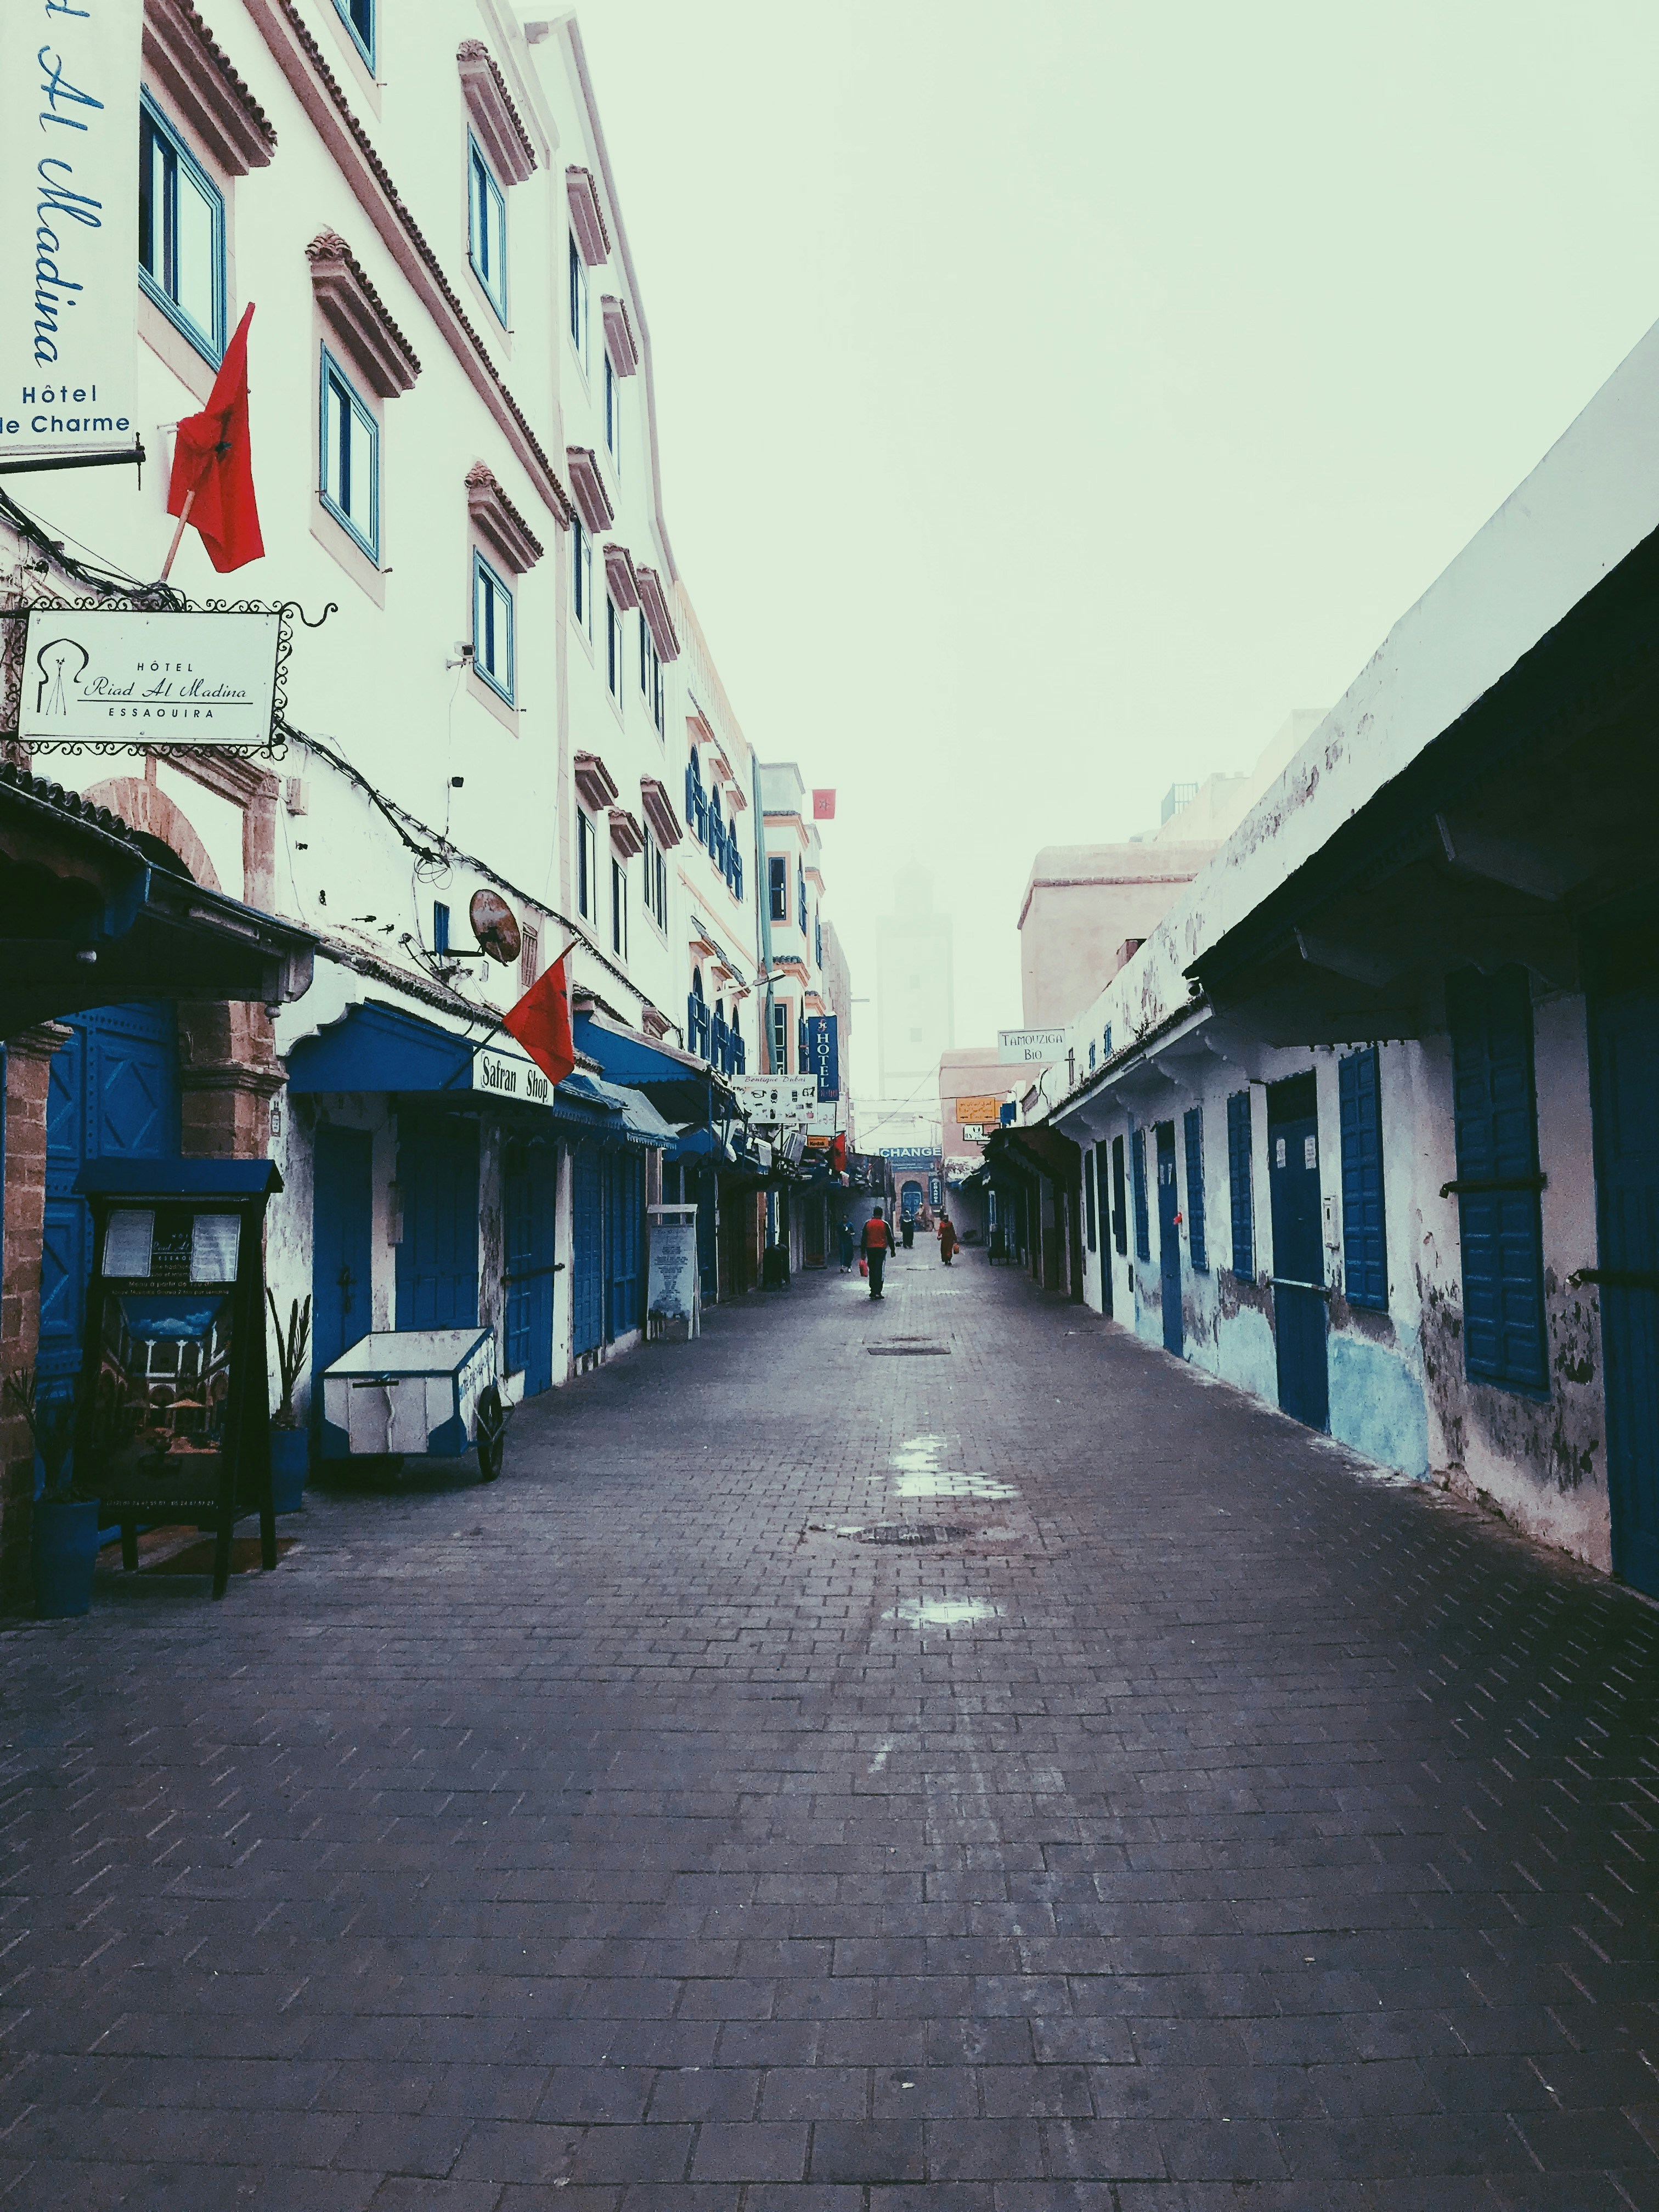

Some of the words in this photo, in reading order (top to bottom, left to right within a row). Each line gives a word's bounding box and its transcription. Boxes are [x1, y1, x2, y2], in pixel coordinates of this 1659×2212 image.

[35, 158, 103, 368] Madina
[22, 385, 96, 404] Hôtel
[31, 415, 129, 433] Charme
[137, 660, 193, 672] HÔTEL
[84, 676, 135, 696] Riad
[142, 678, 173, 697] Al
[179, 678, 247, 698] Madina
[109, 708, 213, 718] ESSAOUIRA
[817, 1033, 830, 1087] HOTEL
[483, 1056, 516, 1092] Safran
[526, 1069, 548, 1103] Shop
[880, 1147, 942, 1158] CHANGE
